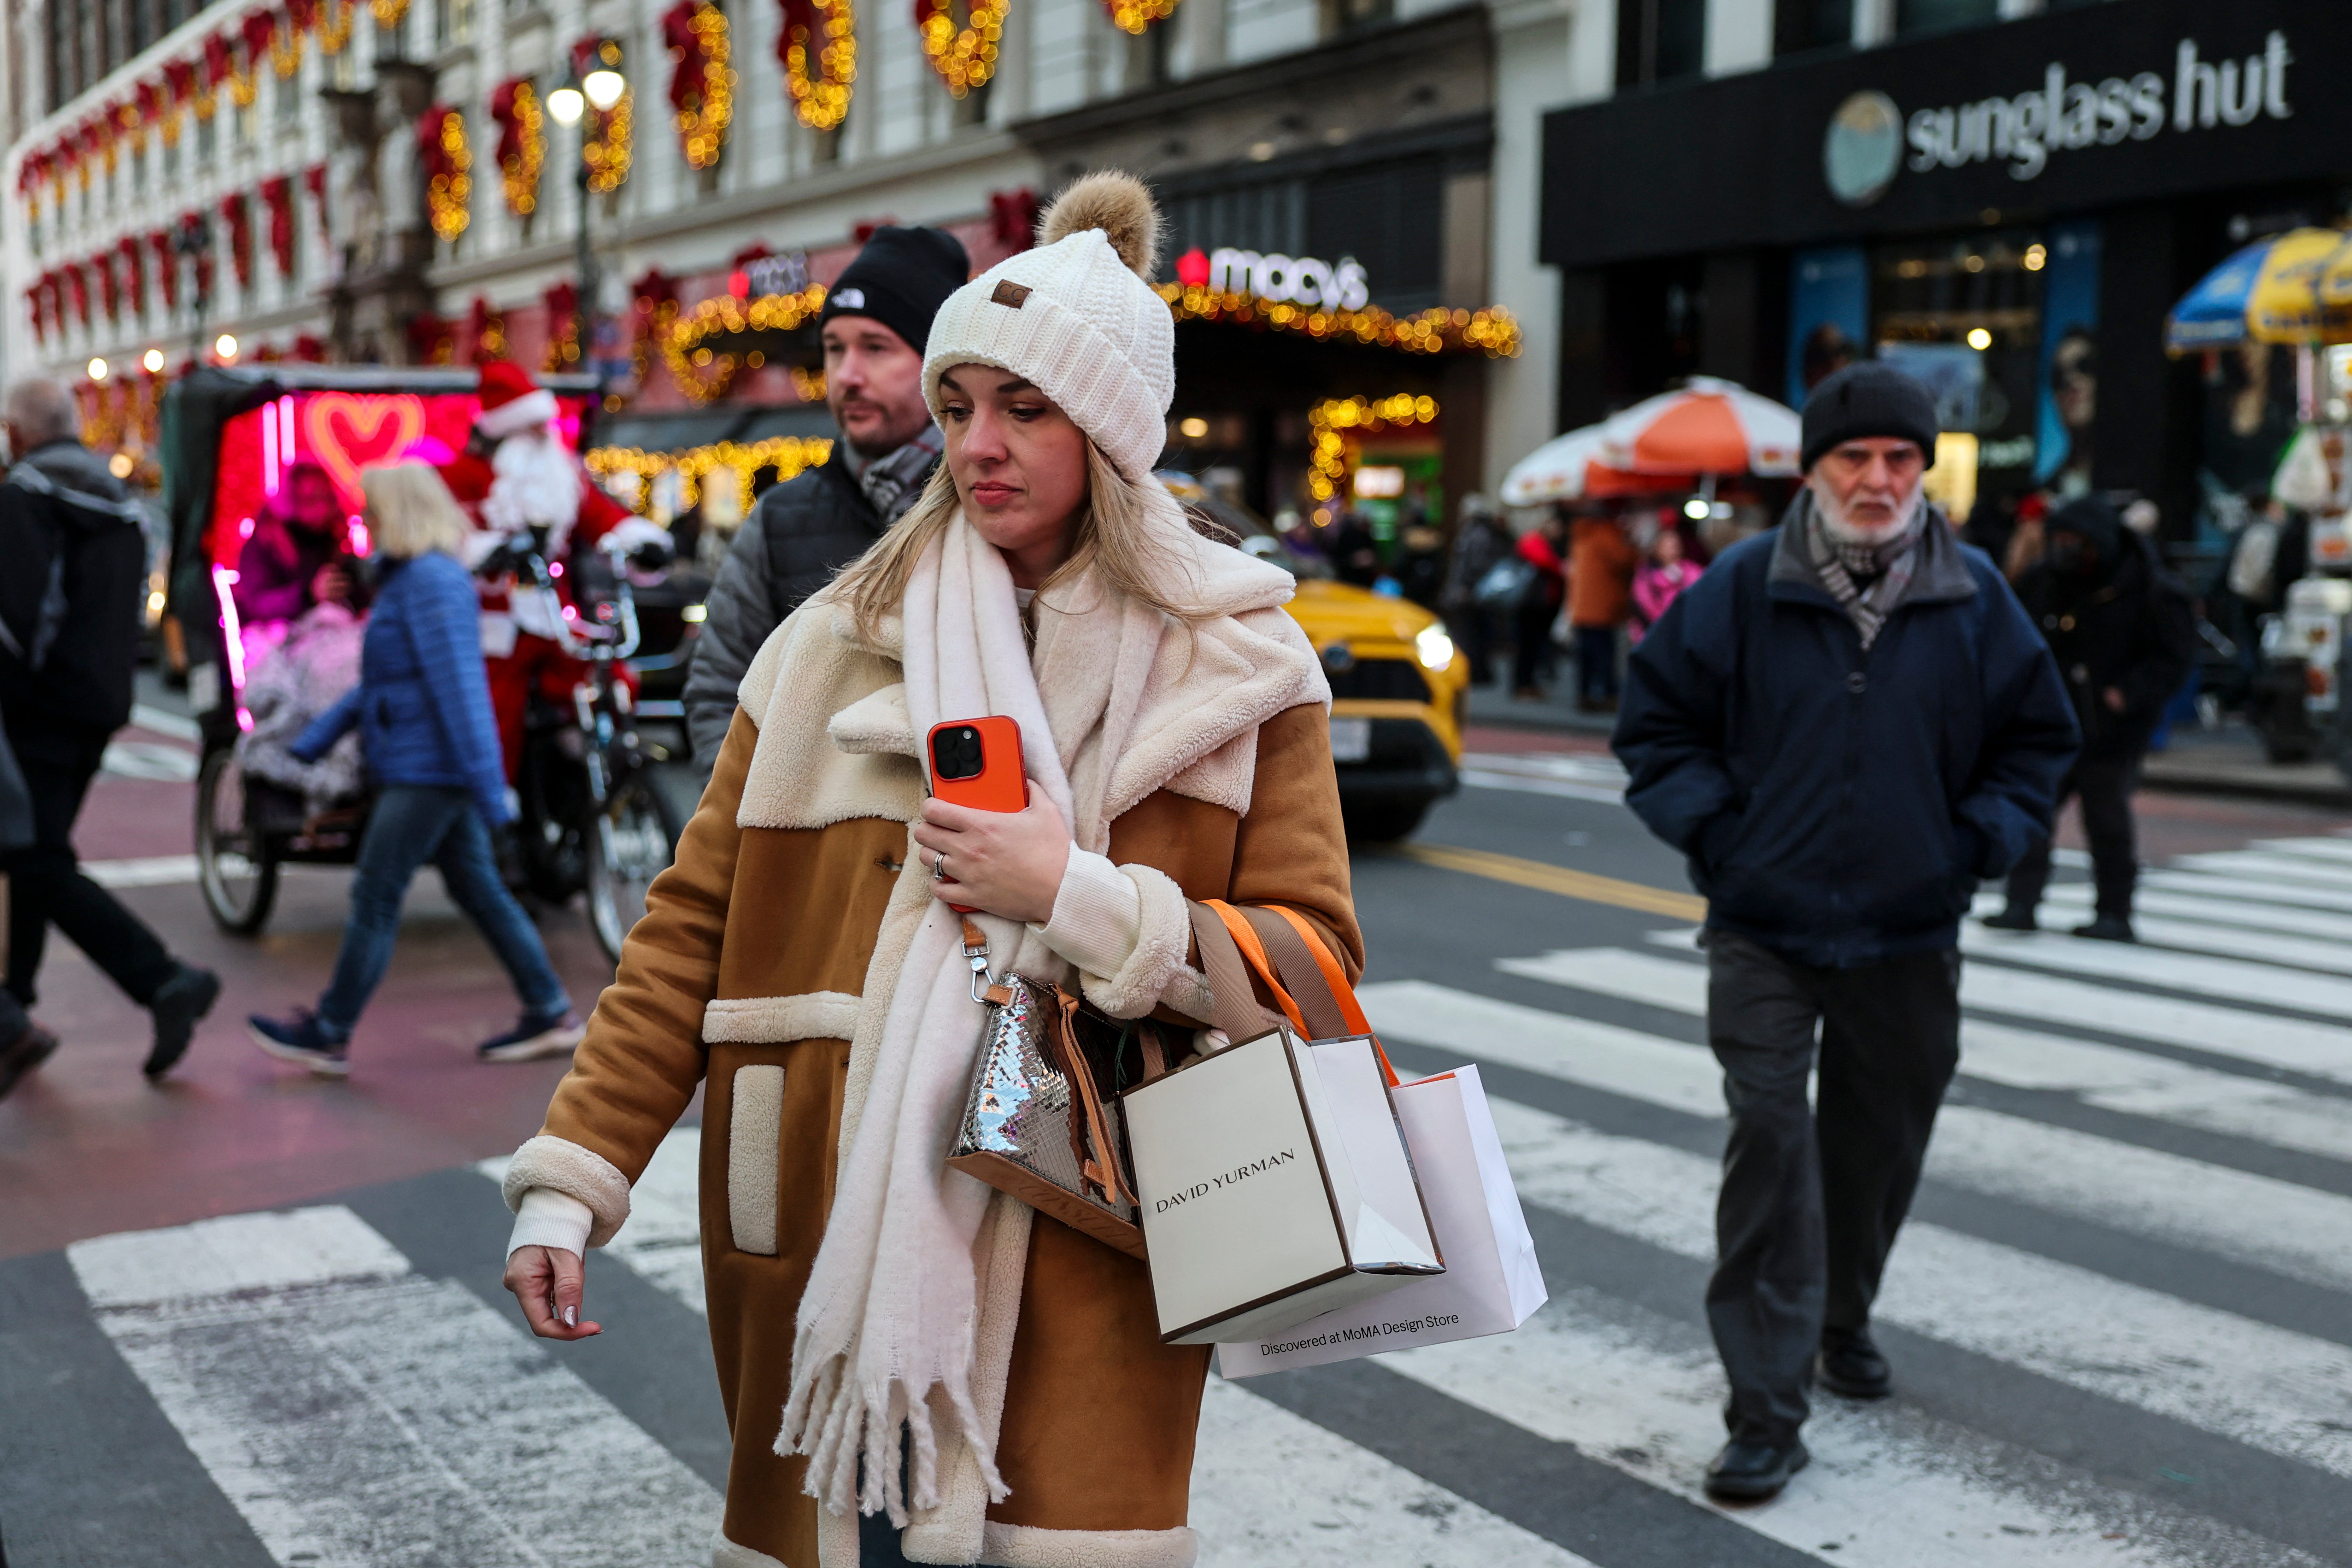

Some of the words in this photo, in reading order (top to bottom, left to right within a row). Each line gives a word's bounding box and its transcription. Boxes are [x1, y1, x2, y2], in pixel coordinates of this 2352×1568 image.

[1907, 62, 2165, 181] sunglass
[2173, 30, 2294, 132] hut
[1156, 1183, 1208, 1213] DAVID
[1212, 1148, 1294, 1188] YURMAN
[1261, 1334, 1327, 1356] Discovered
[1329, 1332, 1341, 1344] at
[1343, 1325, 1381, 1341] MoMA
[1382, 1319, 1424, 1335] Design
[1425, 1314, 1459, 1328] Store
